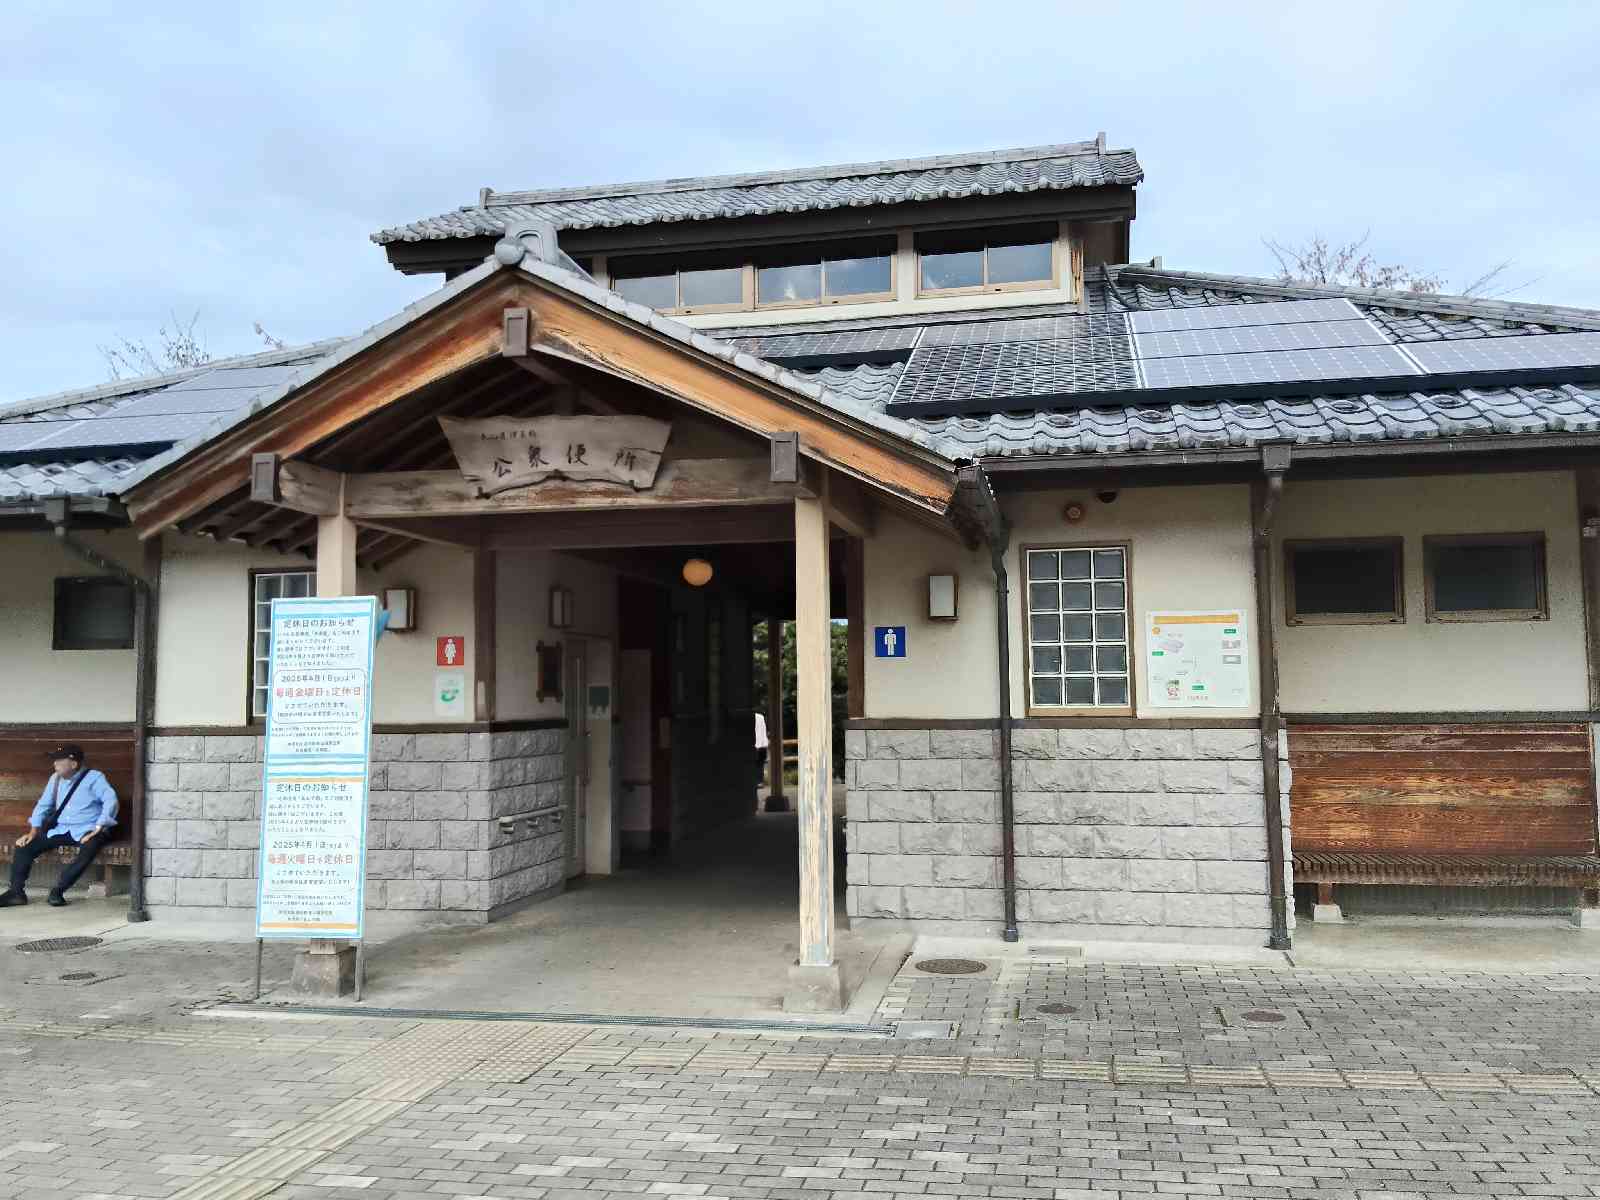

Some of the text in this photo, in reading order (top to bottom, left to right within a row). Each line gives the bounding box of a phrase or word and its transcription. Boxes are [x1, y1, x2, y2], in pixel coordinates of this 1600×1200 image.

[493, 443, 637, 478] 公衆便所
[284, 618, 355, 629] 定休日のお知らせ
[276, 783, 347, 793] 定休日のお知らせ
